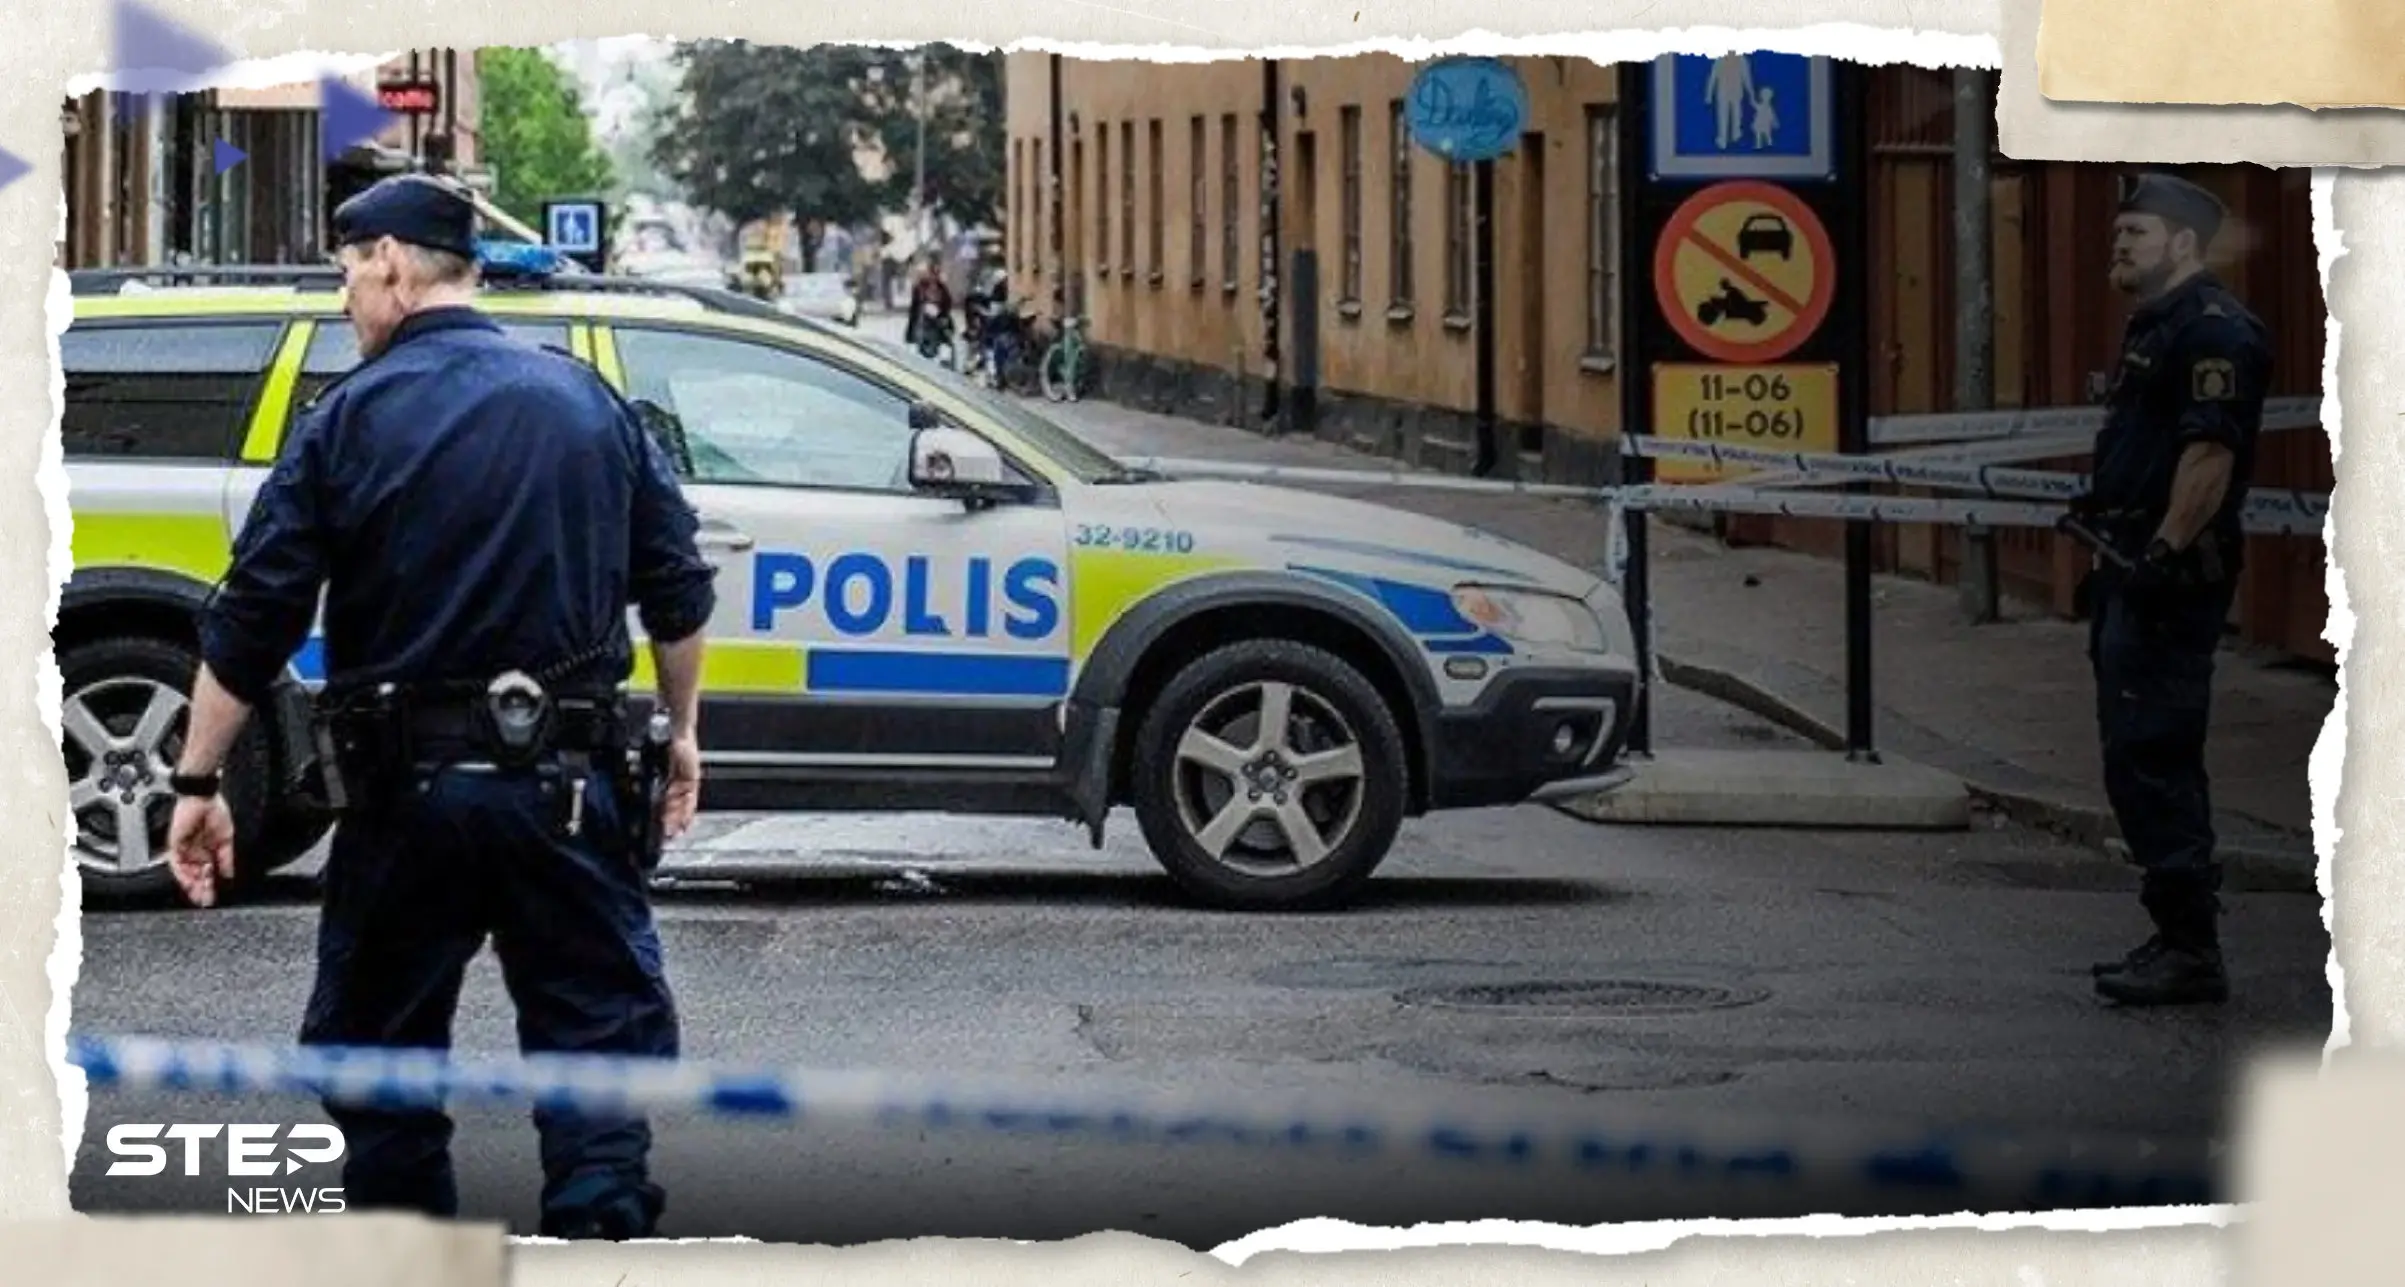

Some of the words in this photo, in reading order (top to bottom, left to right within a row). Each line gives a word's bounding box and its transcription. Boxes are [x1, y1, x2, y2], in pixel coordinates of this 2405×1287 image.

[1701, 373, 1791, 401] 11-06
[1688, 408, 1804, 439] (11-06)
[1074, 524, 1196, 553] 32-9210
[752, 551, 1060, 640] POLIS
